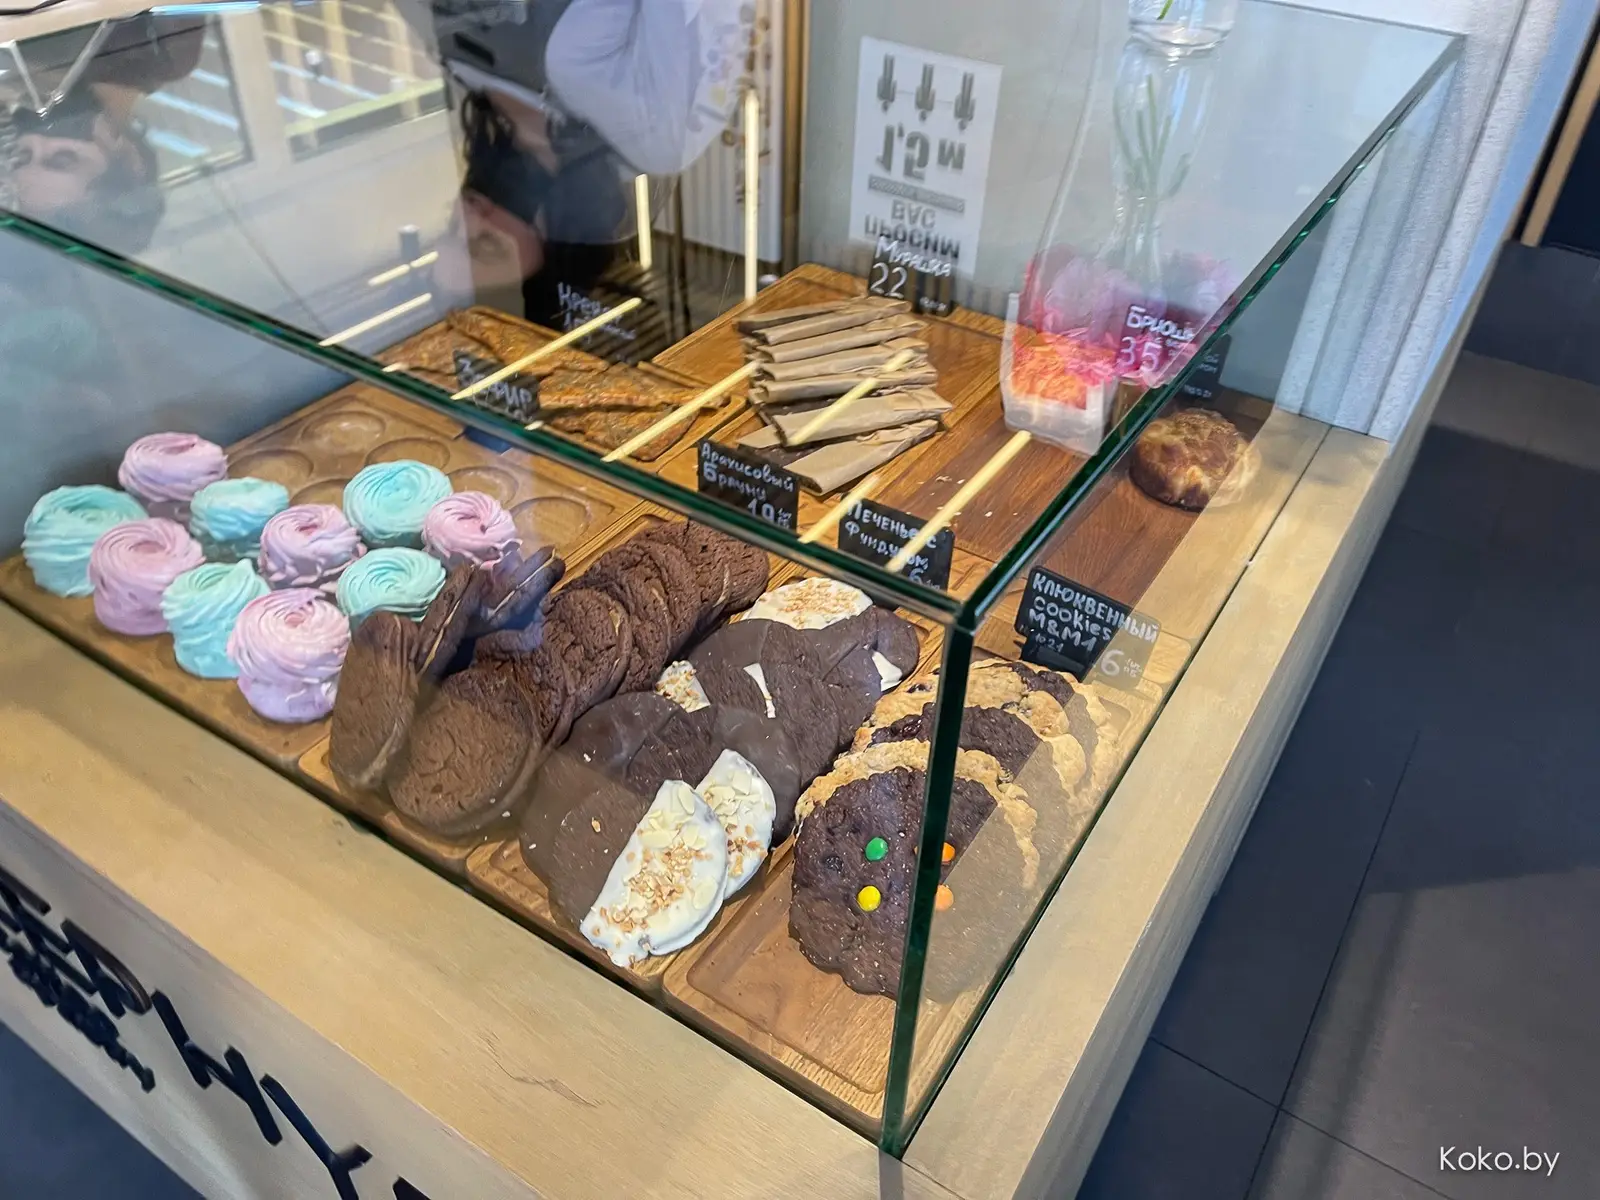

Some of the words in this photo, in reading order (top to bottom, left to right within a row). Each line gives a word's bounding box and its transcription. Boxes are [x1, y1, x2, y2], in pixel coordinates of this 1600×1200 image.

[870, 262, 908, 299] 22
[1117, 336, 1162, 372] 35
[1032, 573, 1158, 643] КЛЮКВЕННЫЙ
